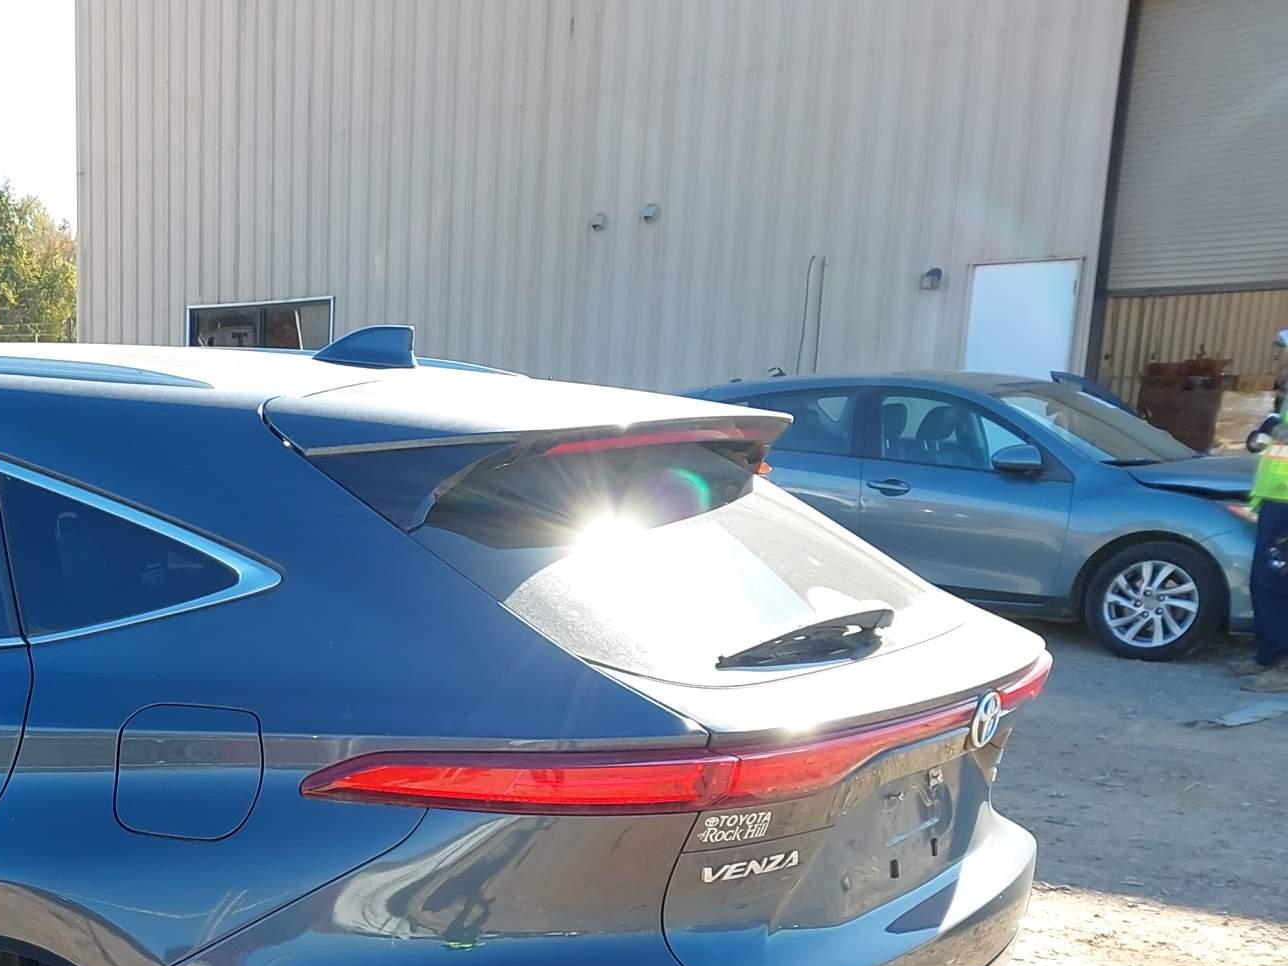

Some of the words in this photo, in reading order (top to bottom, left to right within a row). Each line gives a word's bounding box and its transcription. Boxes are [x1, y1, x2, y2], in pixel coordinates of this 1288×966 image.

[719, 811, 772, 828] TOYOTA
[702, 826, 745, 843] Rock
[743, 822, 770, 840] Hill
[701, 850, 799, 883] VENZA
